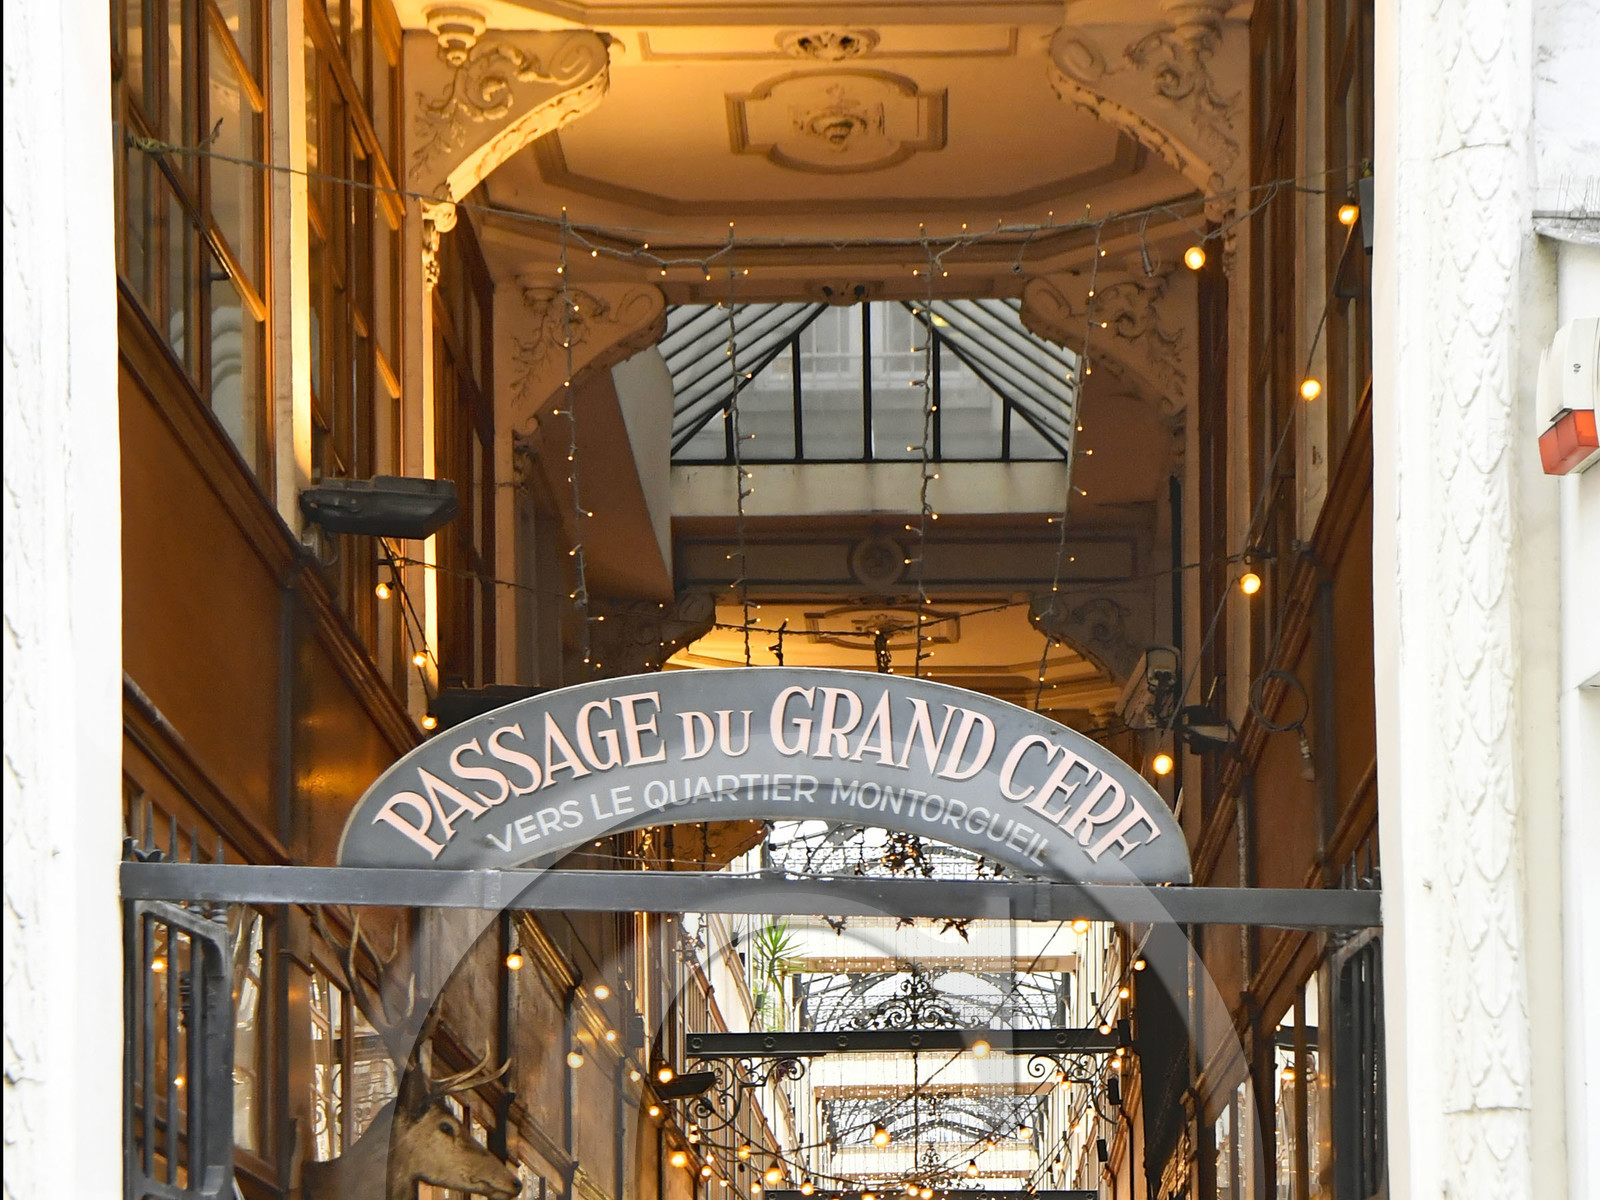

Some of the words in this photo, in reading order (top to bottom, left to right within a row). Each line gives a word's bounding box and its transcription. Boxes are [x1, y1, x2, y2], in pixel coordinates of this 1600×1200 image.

[372, 691, 666, 860] PASSAGE
[675, 710, 755, 761] DU
[770, 686, 997, 780] GRAND
[999, 734, 1162, 864] CERF
[486, 800, 584, 853] VERS
[590, 785, 635, 821] LE
[644, 774, 819, 813] QUARTIER
[831, 777, 1049, 868] MONTORGUEIL
